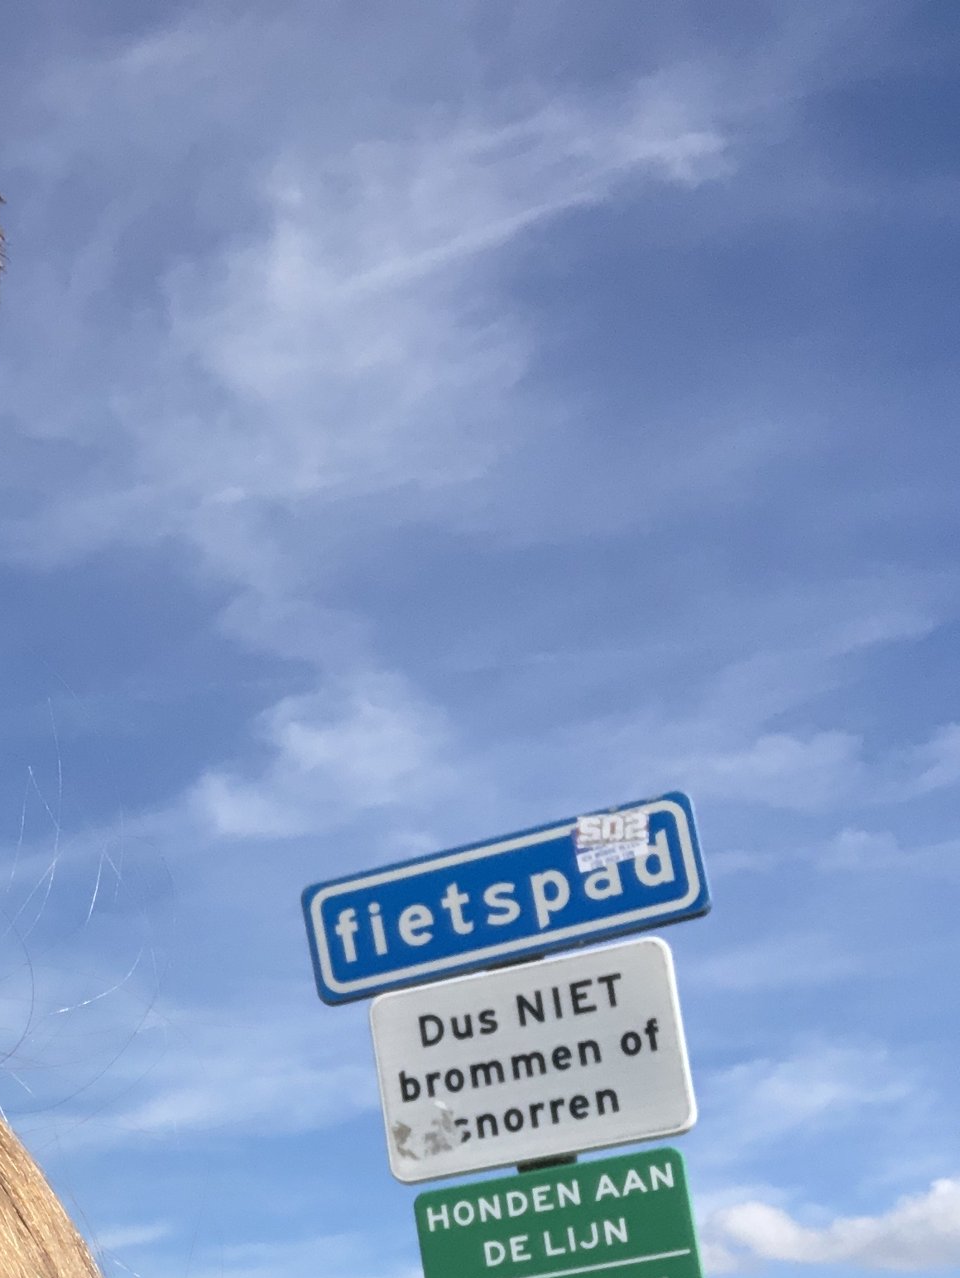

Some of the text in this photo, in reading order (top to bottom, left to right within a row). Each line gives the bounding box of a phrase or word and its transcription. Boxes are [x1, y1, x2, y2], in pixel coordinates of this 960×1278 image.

[335, 829, 677, 964] fietspad
[418, 972, 622, 1048] Dus NIET
[398, 1017, 660, 1103] brommen of
[426, 1162, 675, 1232] HONDEN AAN
[483, 1217, 628, 1267] DE LIJN
